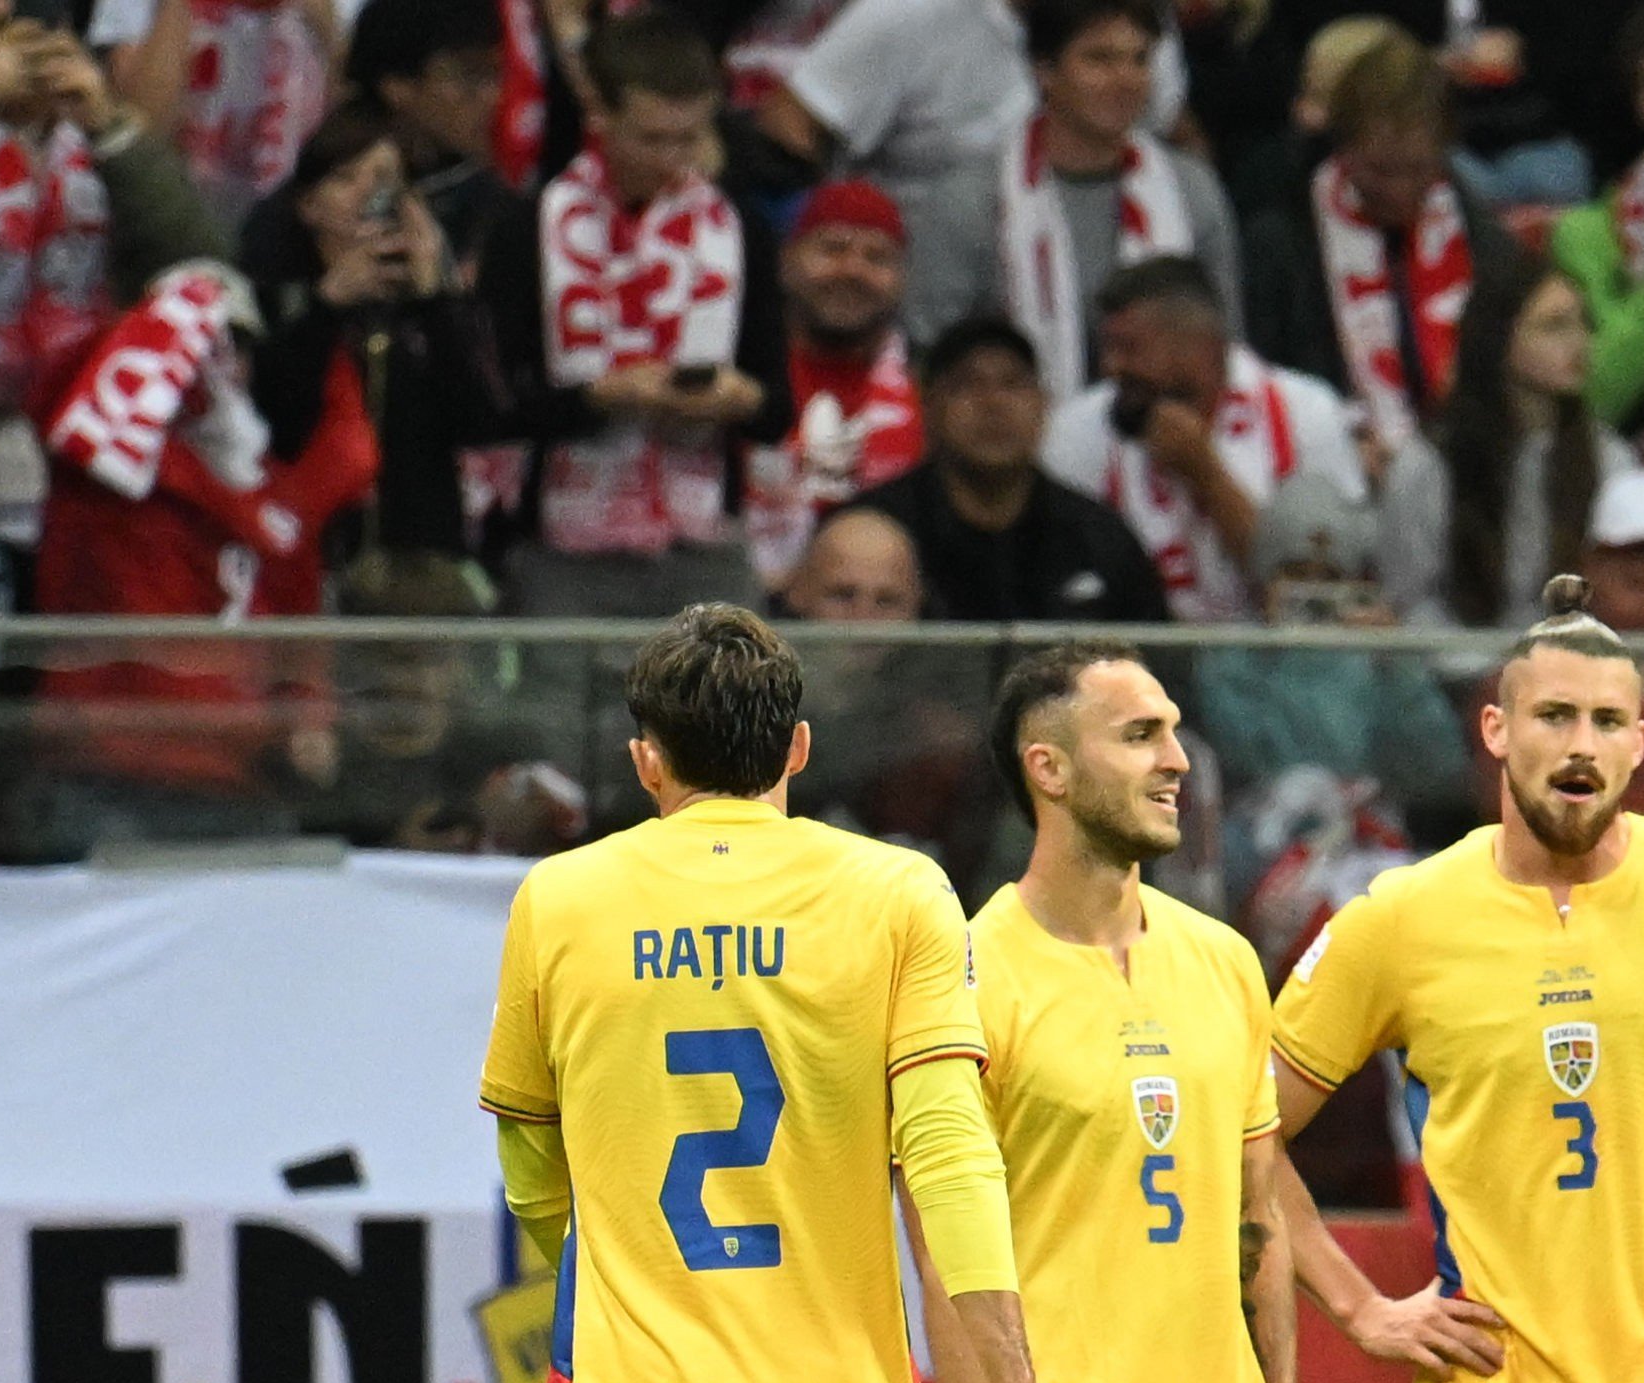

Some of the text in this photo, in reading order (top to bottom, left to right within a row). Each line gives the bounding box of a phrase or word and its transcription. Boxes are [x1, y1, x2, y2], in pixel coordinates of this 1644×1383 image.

[633, 925, 785, 991] RAȚIU
[658, 1027, 786, 1272] 2
[1552, 1100, 1599, 1191] 3
[1139, 1154, 1185, 1244] 5
